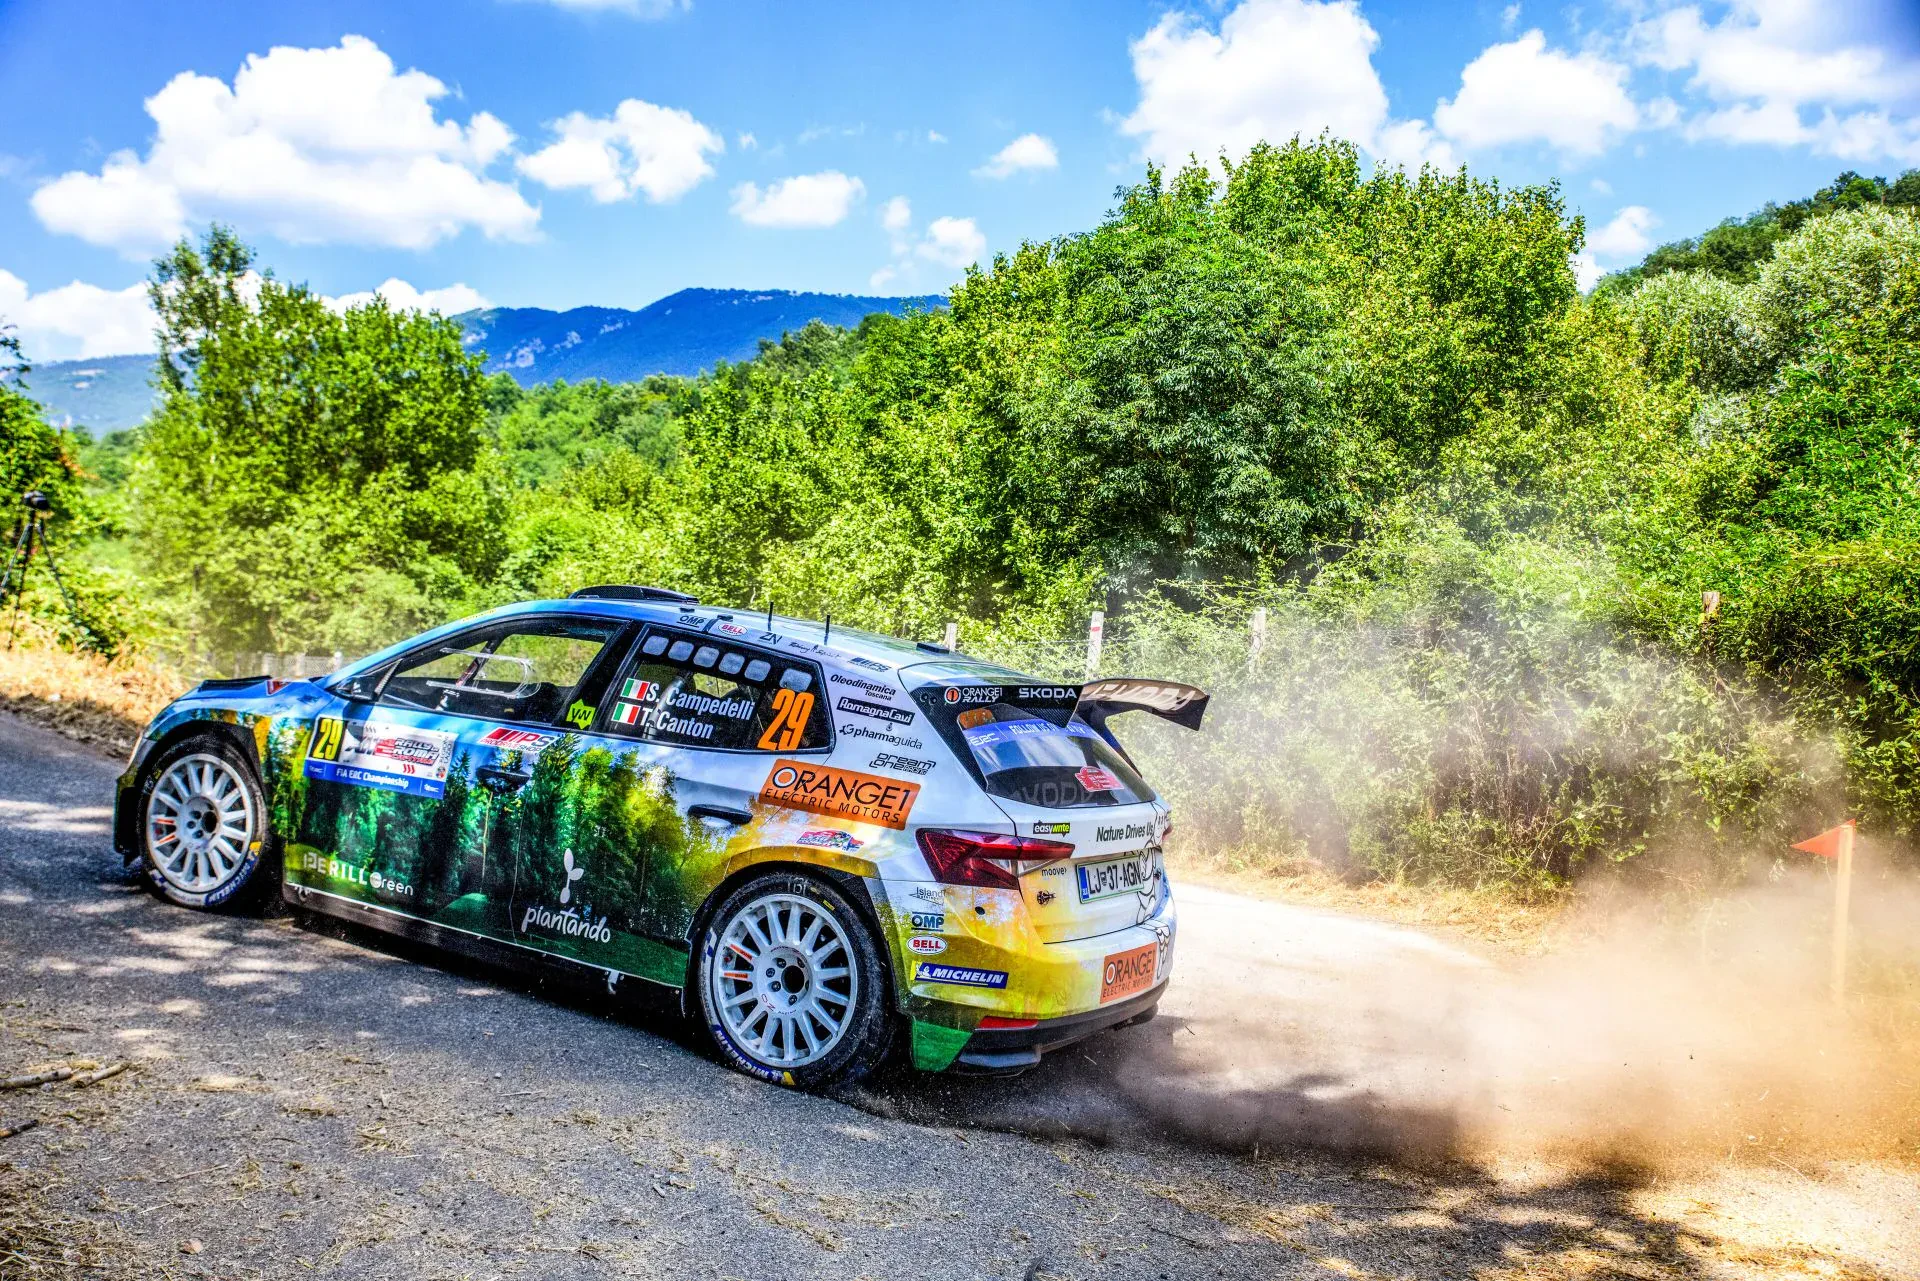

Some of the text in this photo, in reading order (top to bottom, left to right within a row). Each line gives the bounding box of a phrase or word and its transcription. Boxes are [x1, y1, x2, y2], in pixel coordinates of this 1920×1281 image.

[679, 614, 705, 626] OMP
[721, 623, 743, 634] BELL
[830, 674, 896, 696] Oleodinamica
[962, 687, 1003, 697] ORANGE1
[646, 682, 756, 721] S. Campedelli
[865, 690, 892, 701] Toscana
[757, 687, 815, 751] 29
[840, 698, 913, 723] RomagnaCavi
[656, 711, 714, 740] Canton
[312, 717, 344, 761] 29
[395, 737, 434, 750] RALLY
[393, 746, 440, 761] ROMA
[336, 767, 349, 779] FIA
[362, 771, 410, 790] Championship
[772, 766, 911, 812] ORANGE1
[764, 787, 901, 824] ELECTRIC MOTORS
[1096, 825, 1124, 843] Nature
[1125, 823, 1145, 841] Drives
[521, 905, 611, 943] piantando
[911, 914, 945, 929] OMP
[912, 939, 942, 949] BELL
[931, 967, 1005, 984] MICHELIN
[1102, 981, 1131, 998] ELECTRIC
